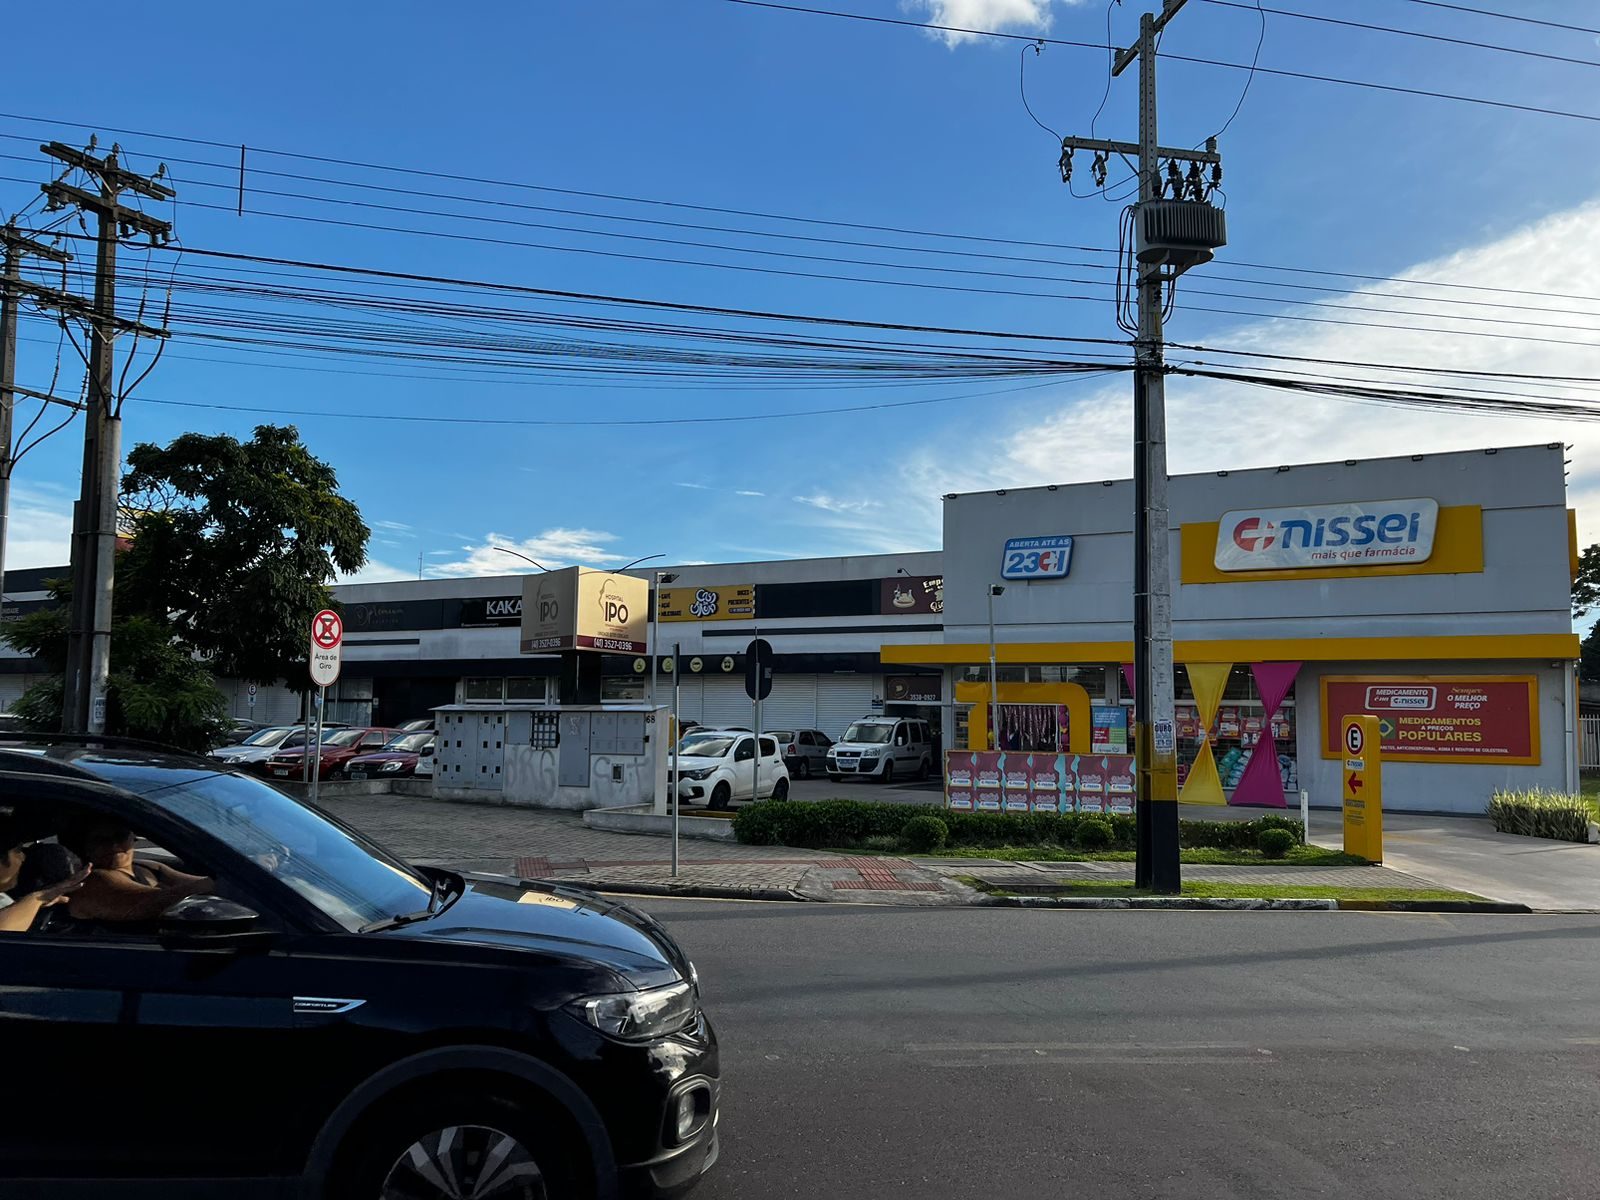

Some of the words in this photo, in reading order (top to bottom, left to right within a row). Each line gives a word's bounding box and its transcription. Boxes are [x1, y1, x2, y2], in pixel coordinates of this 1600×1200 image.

[1280, 512, 1421, 549] nissei
[1009, 540, 1039, 548] ABERTA
[1311, 550, 1337, 560] mais
[1340, 551, 1362, 561] que
[1365, 546, 1416, 557] farmácia
[540, 601, 559, 622] IPO
[604, 601, 629, 624] IPO
[604, 639, 633, 651] 3527-0396
[1454, 702, 1481, 710] PREÇO
[646, 715, 656, 724] 68
[1399, 717, 1481, 726] MEDICAMENTOS
[1350, 729, 1359, 749] E
[1399, 731, 1482, 742] POPULARES
